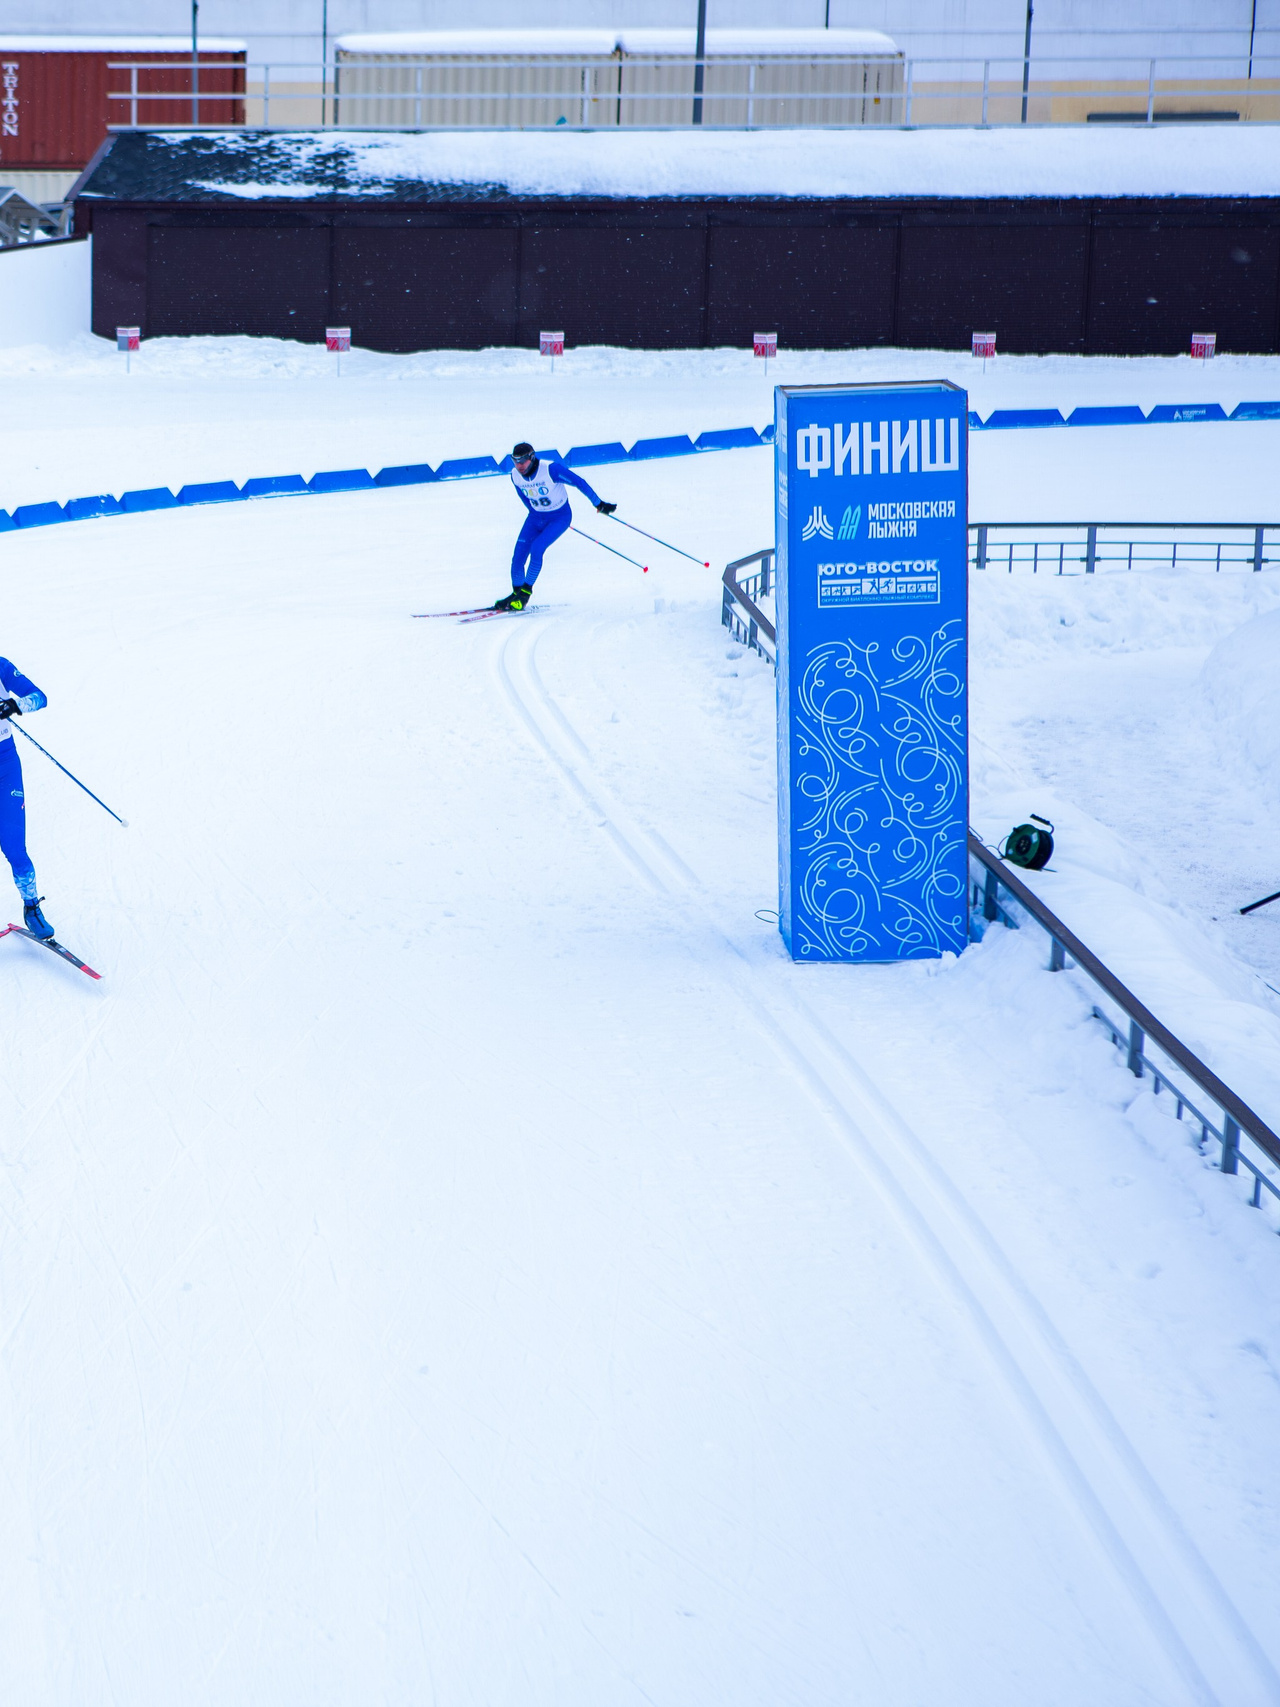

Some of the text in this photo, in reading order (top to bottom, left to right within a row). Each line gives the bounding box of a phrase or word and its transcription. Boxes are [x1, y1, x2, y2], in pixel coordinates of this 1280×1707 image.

[2, 62, 19, 136] TRITON
[797, 418, 959, 478] ФИНИШ
[868, 501, 956, 520] МОСКОВСКАЯ
[868, 521, 917, 539] ЛЫЖНЯ
[818, 560, 938, 576] ЮГО-ВОСТОК
